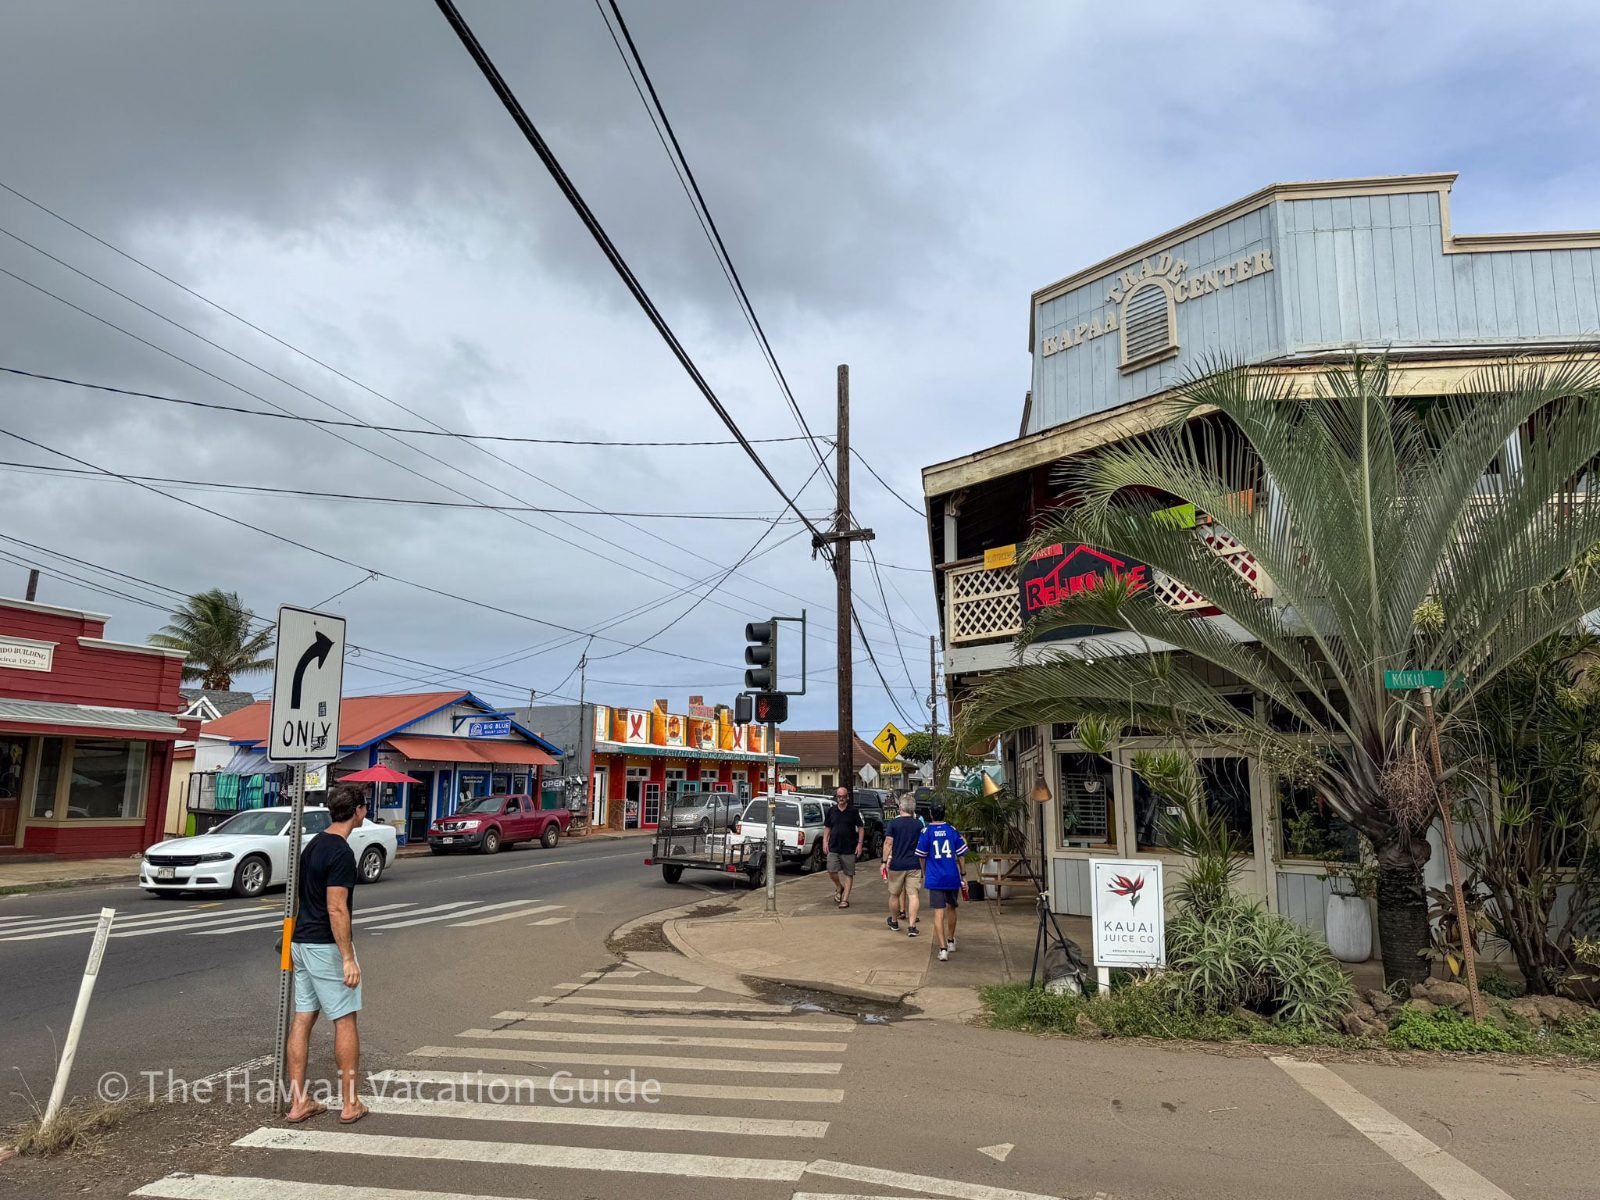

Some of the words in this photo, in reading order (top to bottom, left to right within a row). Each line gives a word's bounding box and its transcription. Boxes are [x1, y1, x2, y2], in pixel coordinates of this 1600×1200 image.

[1105, 253, 1188, 304] TRADE
[1174, 249, 1274, 303] CENTER
[1042, 311, 1119, 358] KAPAA
[14, 647, 46, 660] BUILDING
[1391, 673, 1425, 687] KUKUI
[495, 722, 509, 730] BLUE
[282, 720, 332, 748] ONLY
[541, 779, 565, 789] OPEN
[932, 839, 952, 859] 14
[1104, 921, 1153, 933] KAUAI
[1104, 934, 1134, 942] JUICE
[1140, 935, 1154, 943] CO
